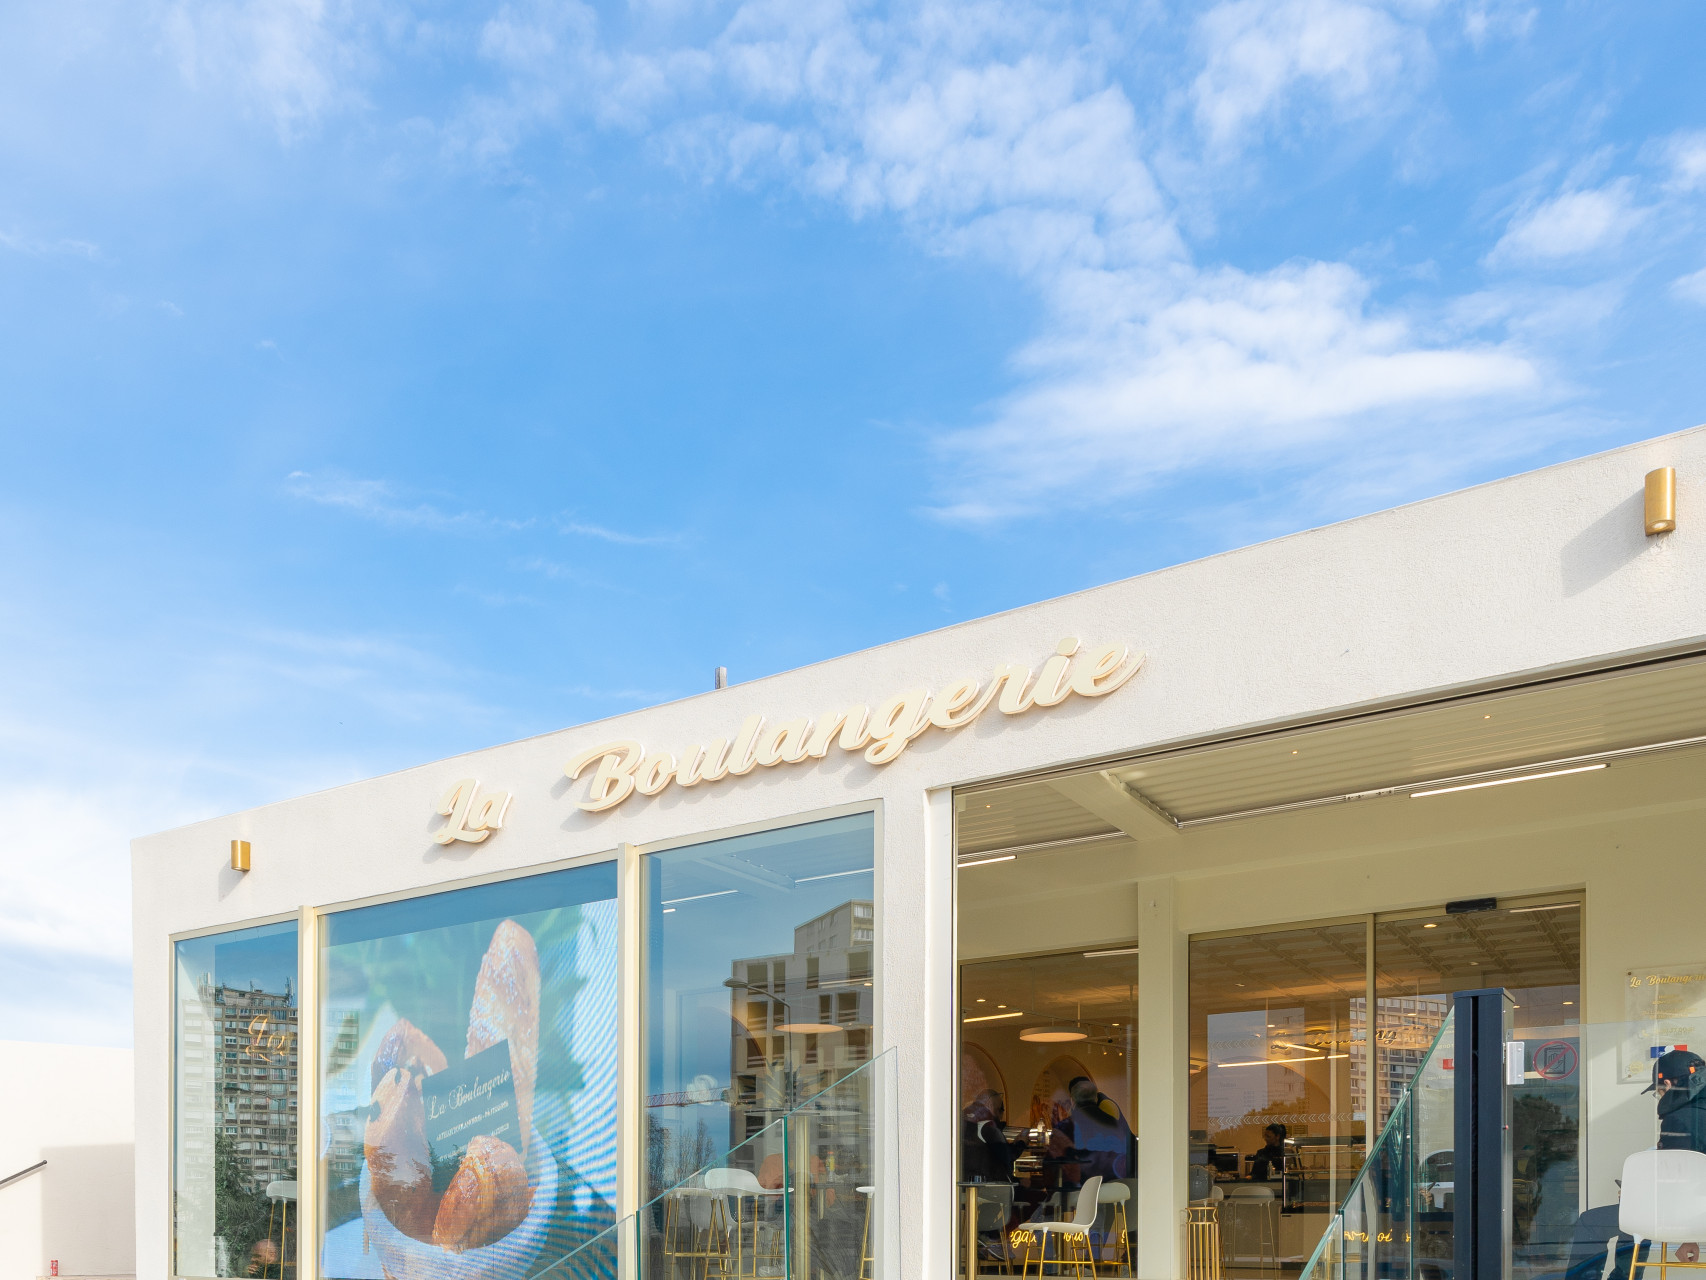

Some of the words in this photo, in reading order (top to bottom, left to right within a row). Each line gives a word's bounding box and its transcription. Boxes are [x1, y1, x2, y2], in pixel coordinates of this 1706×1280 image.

[431, 778, 514, 846] La
[563, 636, 1147, 812] Boulangerie
[1629, 975, 1642, 988] La
[427, 1095, 447, 1121] La
[448, 1068, 511, 1110] Boulangerie
